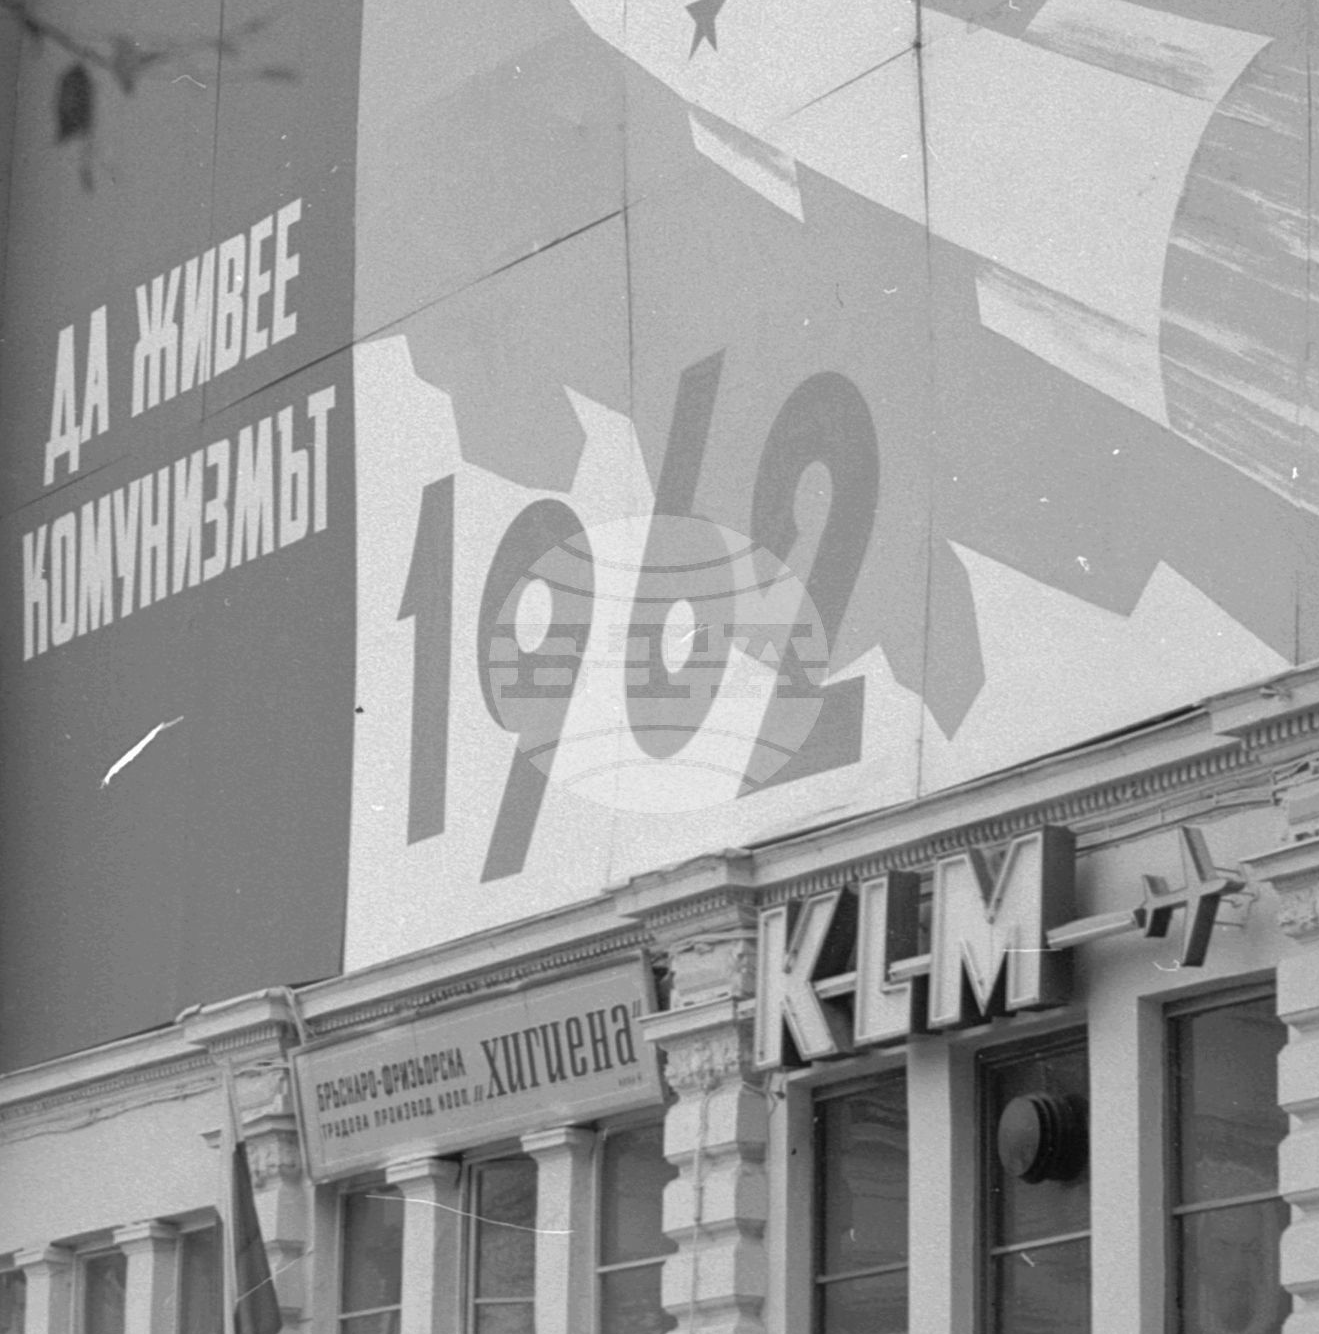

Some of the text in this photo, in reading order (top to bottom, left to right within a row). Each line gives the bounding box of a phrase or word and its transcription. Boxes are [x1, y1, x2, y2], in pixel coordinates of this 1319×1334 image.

[43, 197, 303, 487] ДА ЖИВЕЕ
[22, 385, 337, 662] КОМУНИЗМЪТ
[396, 346, 881, 885] 1962
[754, 826, 1068, 1069] KLM
